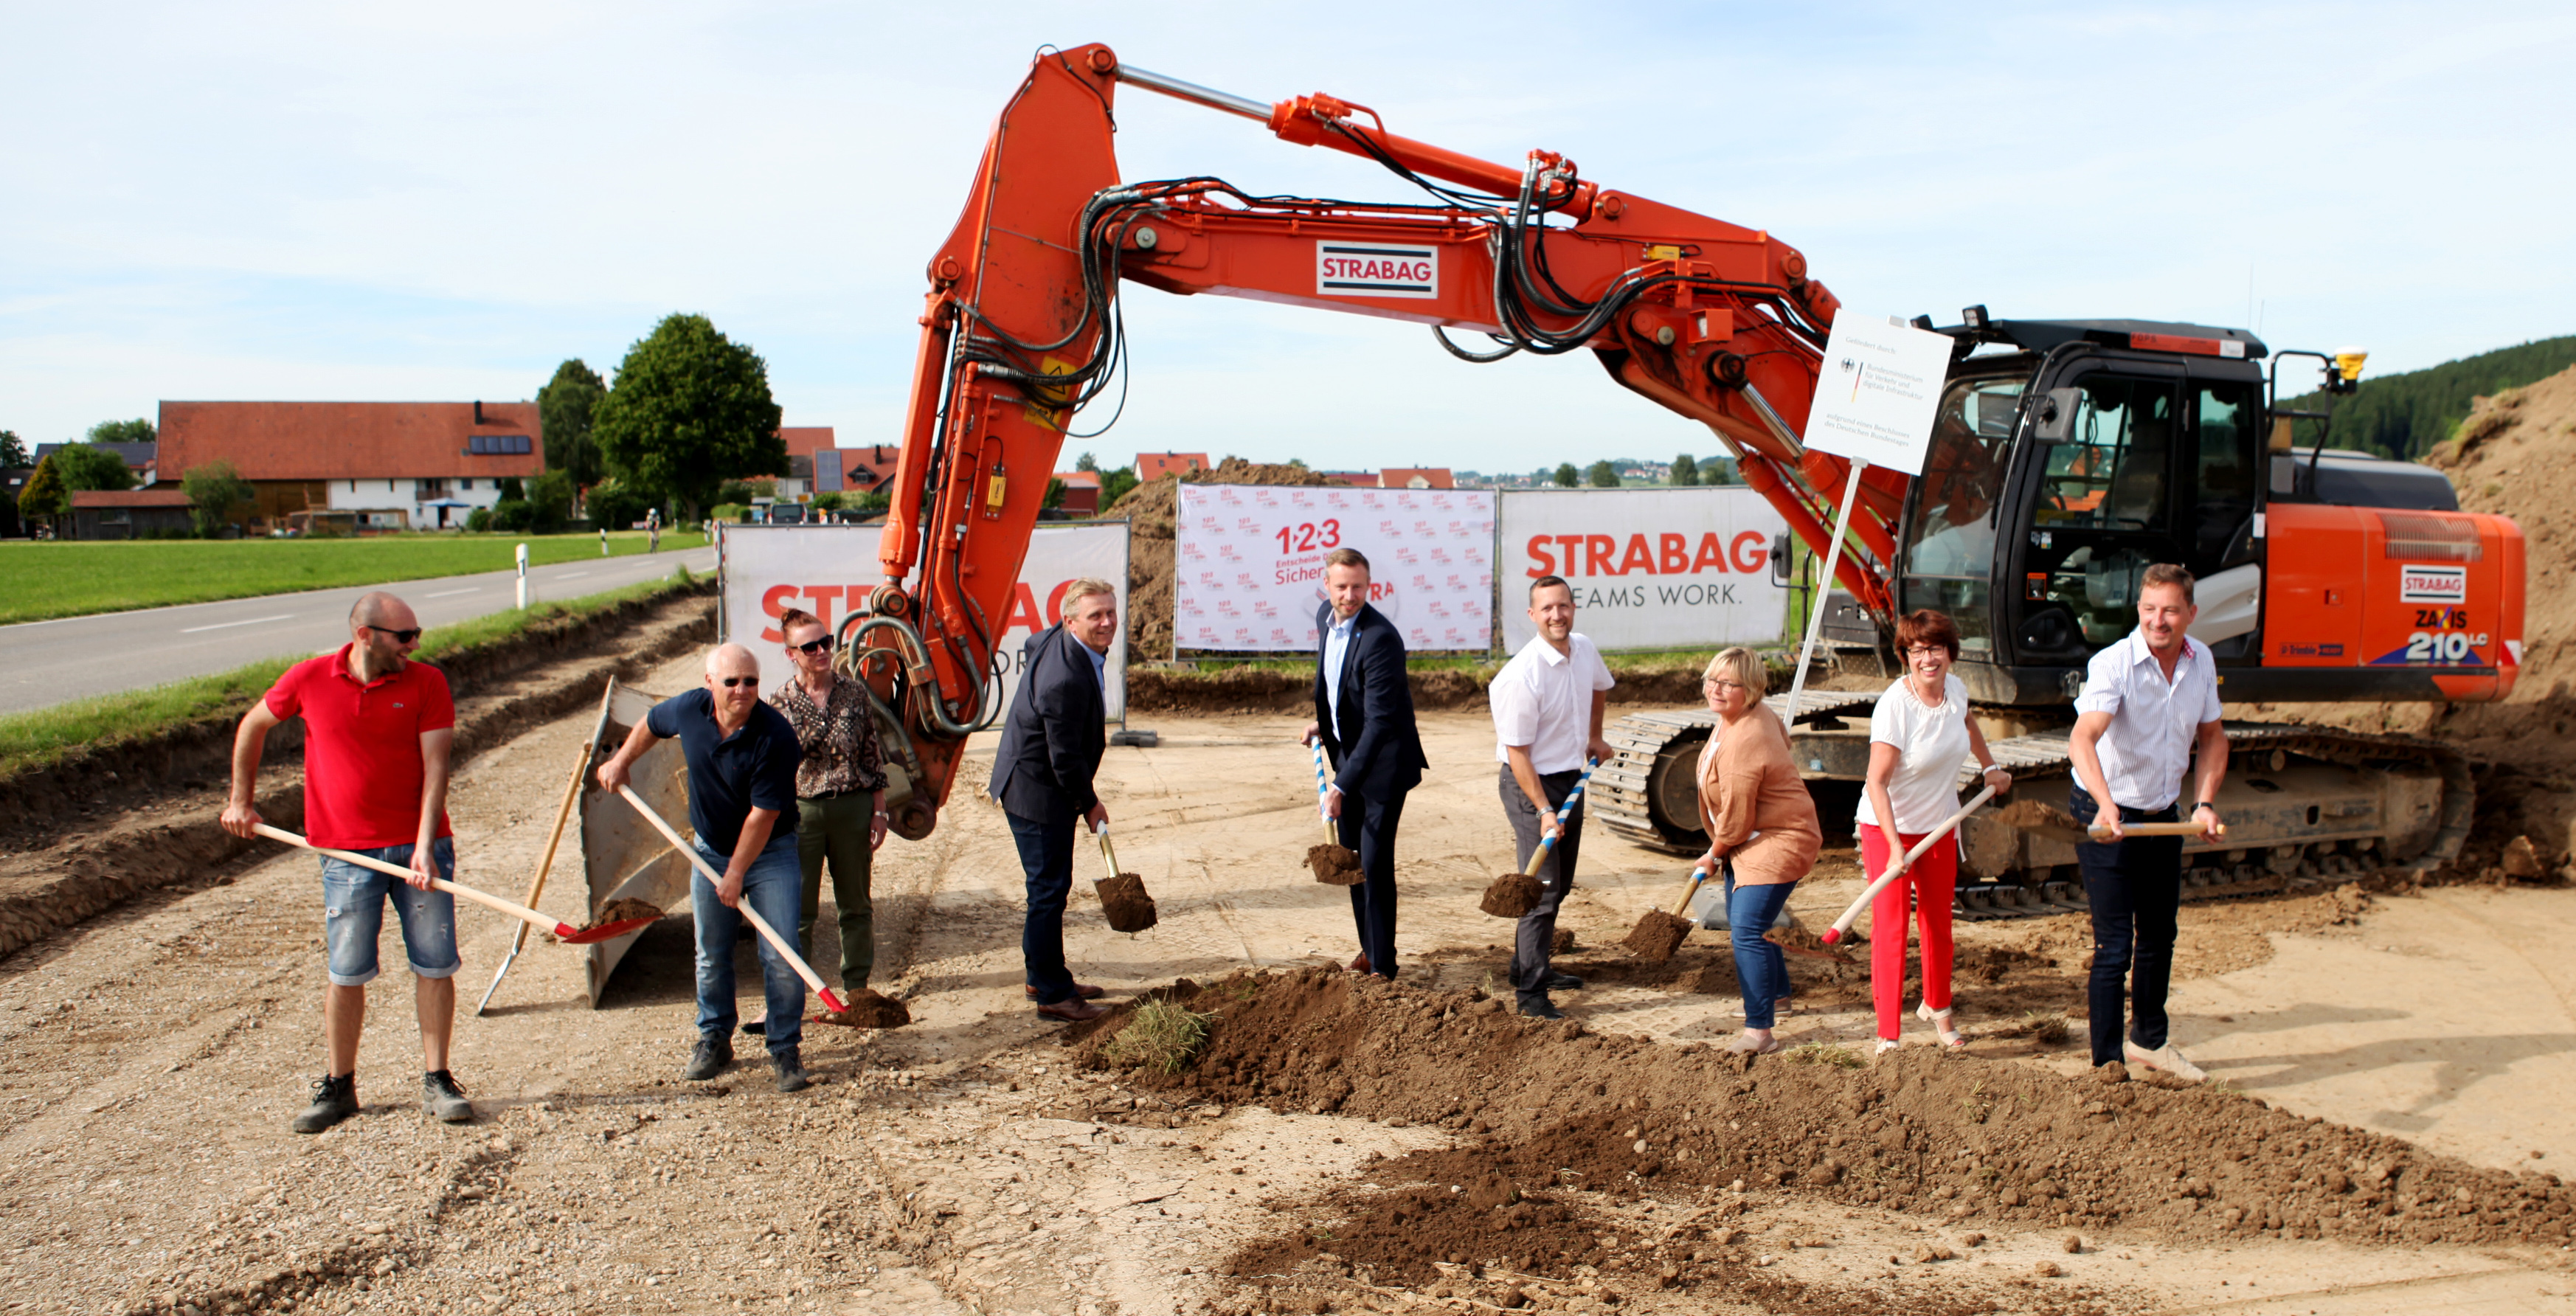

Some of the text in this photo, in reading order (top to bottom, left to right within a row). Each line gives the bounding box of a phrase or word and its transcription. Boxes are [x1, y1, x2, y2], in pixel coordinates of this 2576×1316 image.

[1323, 257, 1432, 282] STRABAG
[1866, 362, 1924, 383] Bundesministerium
[1874, 373, 1897, 384] Verkehr
[1898, 380, 1911, 389] und
[1863, 380, 1923, 400] digitale Infrastruktur
[1827, 413, 1910, 438] aufgrund eines Beschlusses
[1836, 423, 1869, 437] Deutschen
[1870, 432, 1909, 447] Bundestages
[1276, 555, 1321, 568] Entscheide
[1526, 530, 1768, 579] STRABAG
[1275, 567, 1325, 586] Sicher
[2406, 578, 2462, 592] STRABAG
[1573, 583, 1742, 609] EAMS WORK.
[2415, 606, 2467, 629] ZAXIS
[2406, 631, 2489, 661] 210 LC
